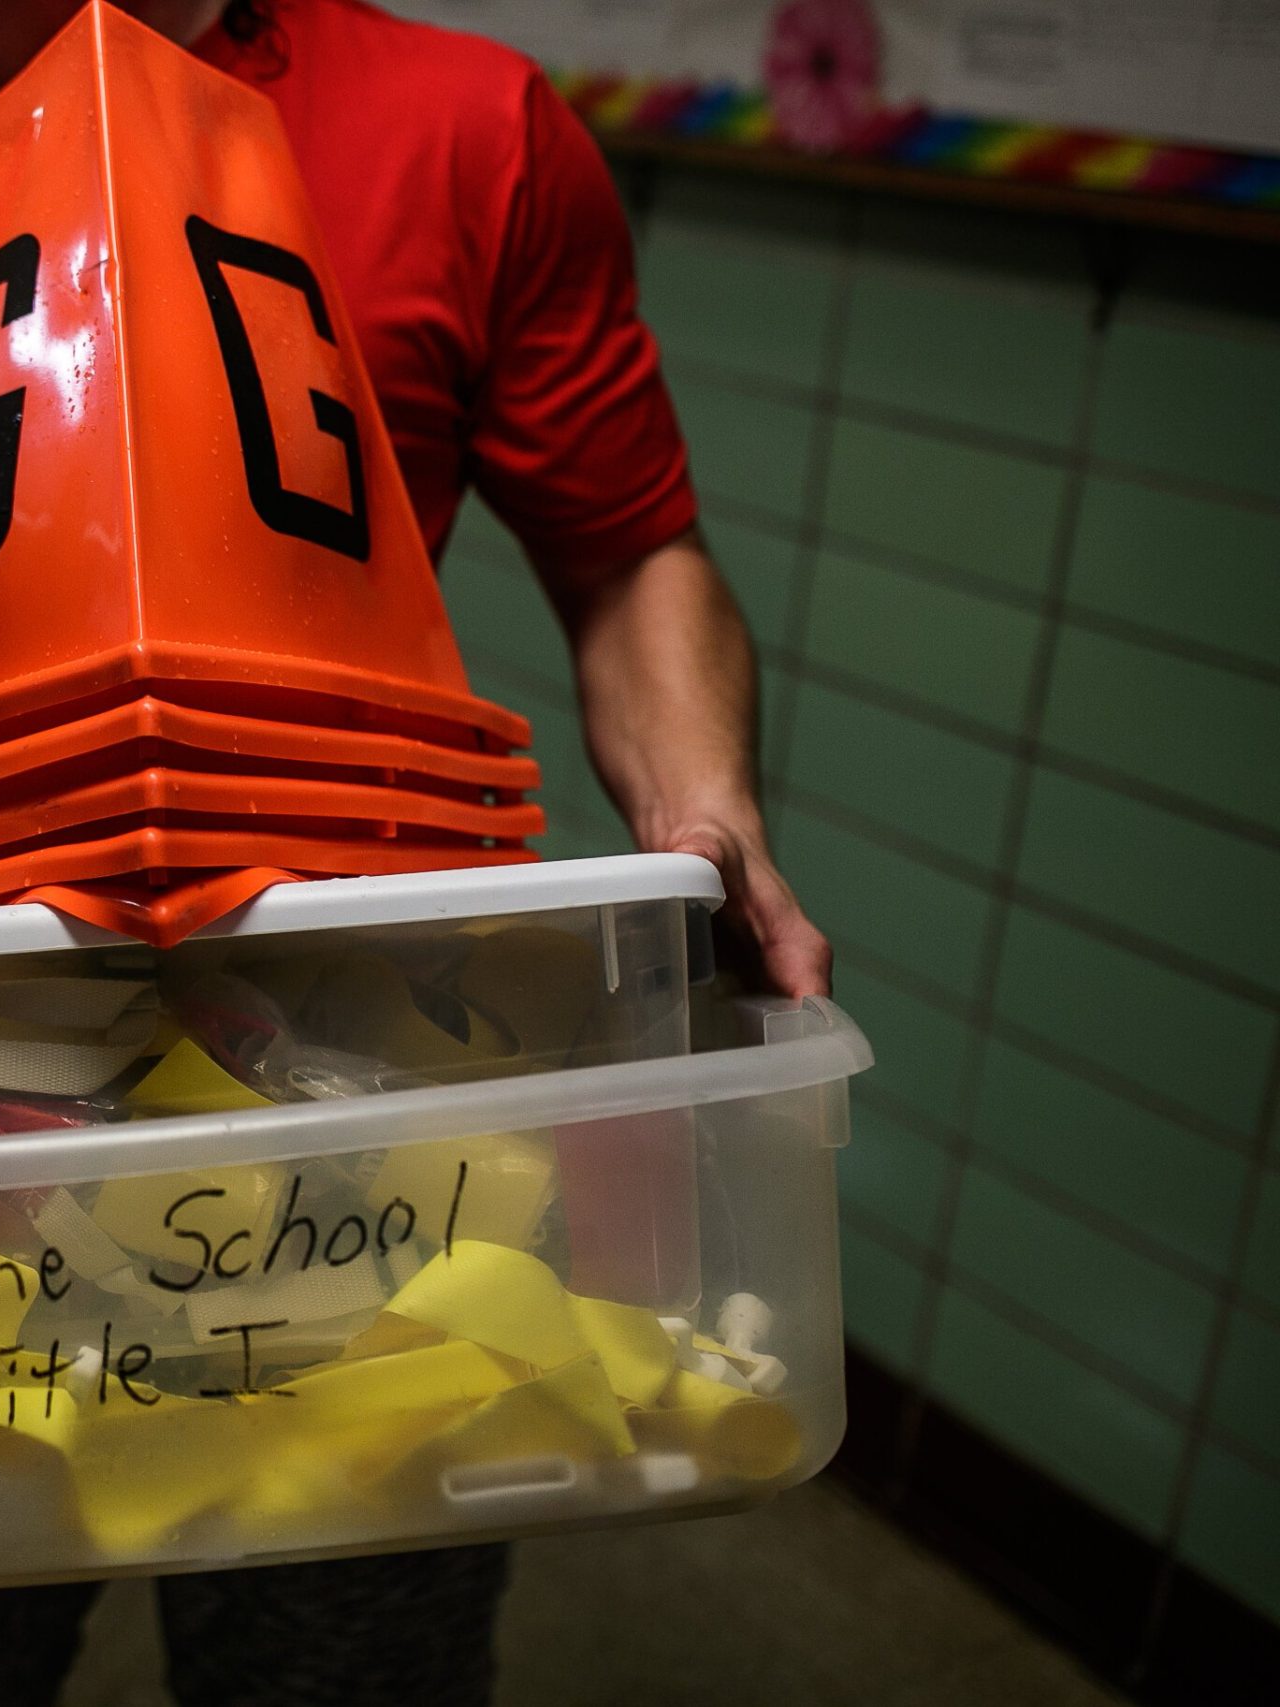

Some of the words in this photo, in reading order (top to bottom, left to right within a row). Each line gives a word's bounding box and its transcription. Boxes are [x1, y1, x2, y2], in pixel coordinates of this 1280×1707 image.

[185, 214, 371, 564] G
[150, 1161, 468, 1292] School
[199, 1320, 297, 1399] I
